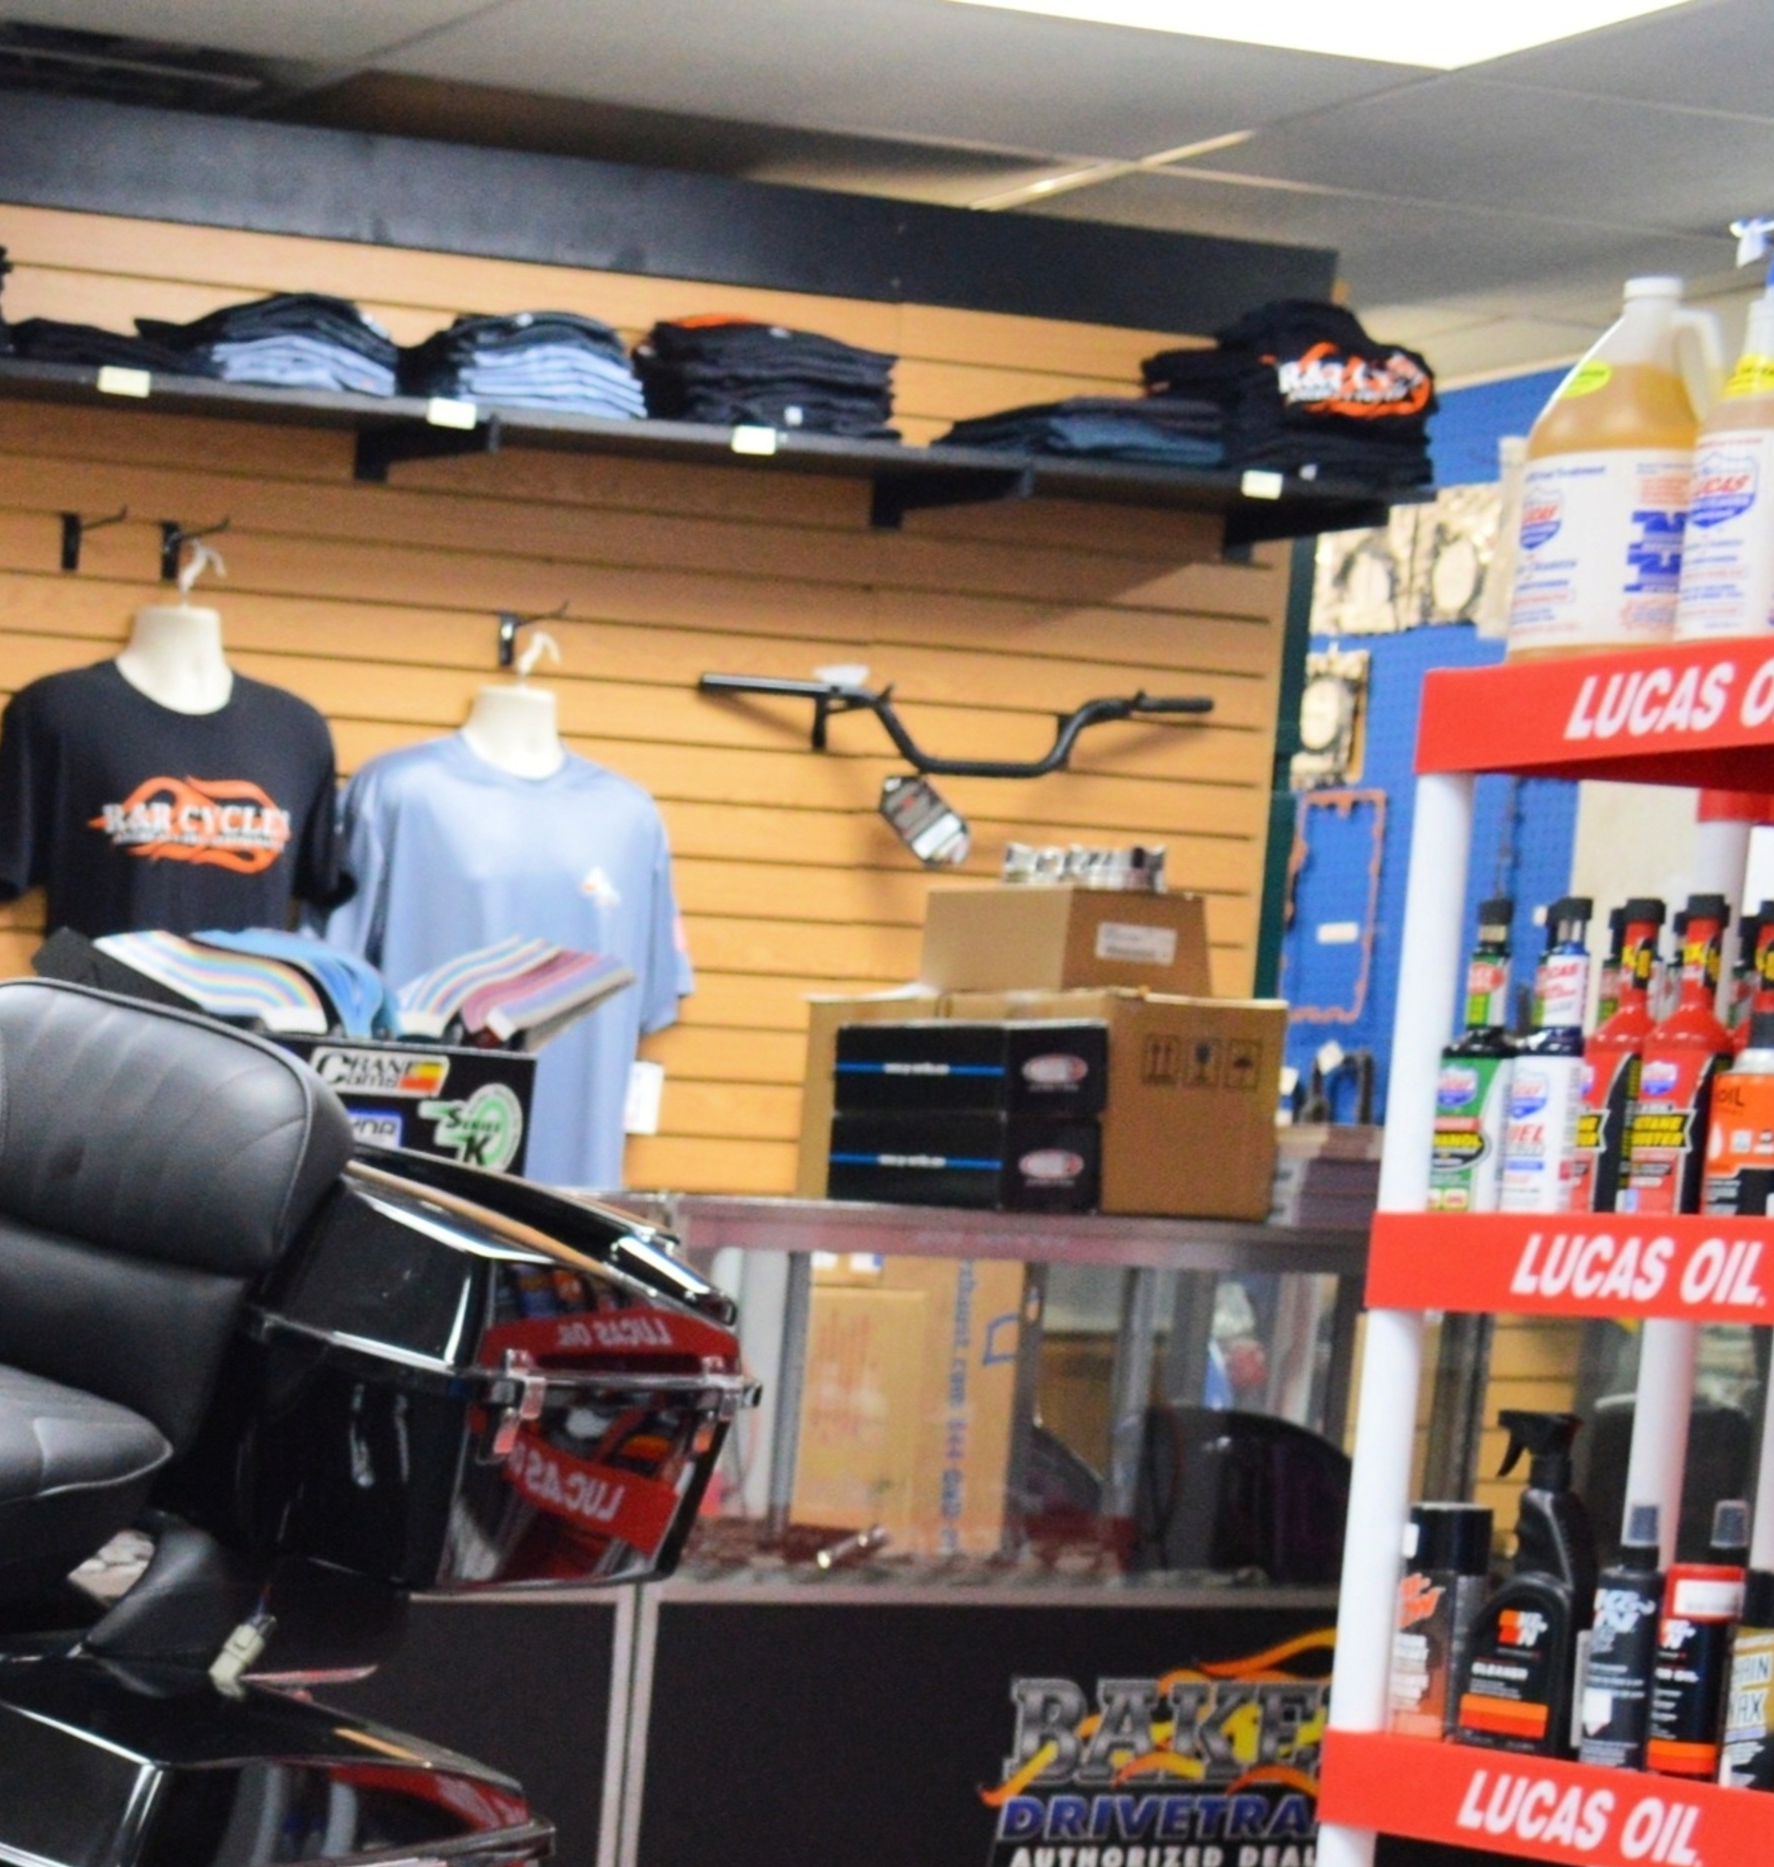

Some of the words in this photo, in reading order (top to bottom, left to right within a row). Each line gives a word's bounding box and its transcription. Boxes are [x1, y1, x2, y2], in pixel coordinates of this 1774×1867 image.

[1563, 661, 1736, 741] LUCAS
[463, 1133, 490, 1166] K
[1510, 1232, 1676, 1300] LUCAS
[1004, 1678, 1331, 1785] BAKE
[998, 1795, 1320, 1841] DRIVETRA
[1456, 1769, 1616, 1852] LUCAS
